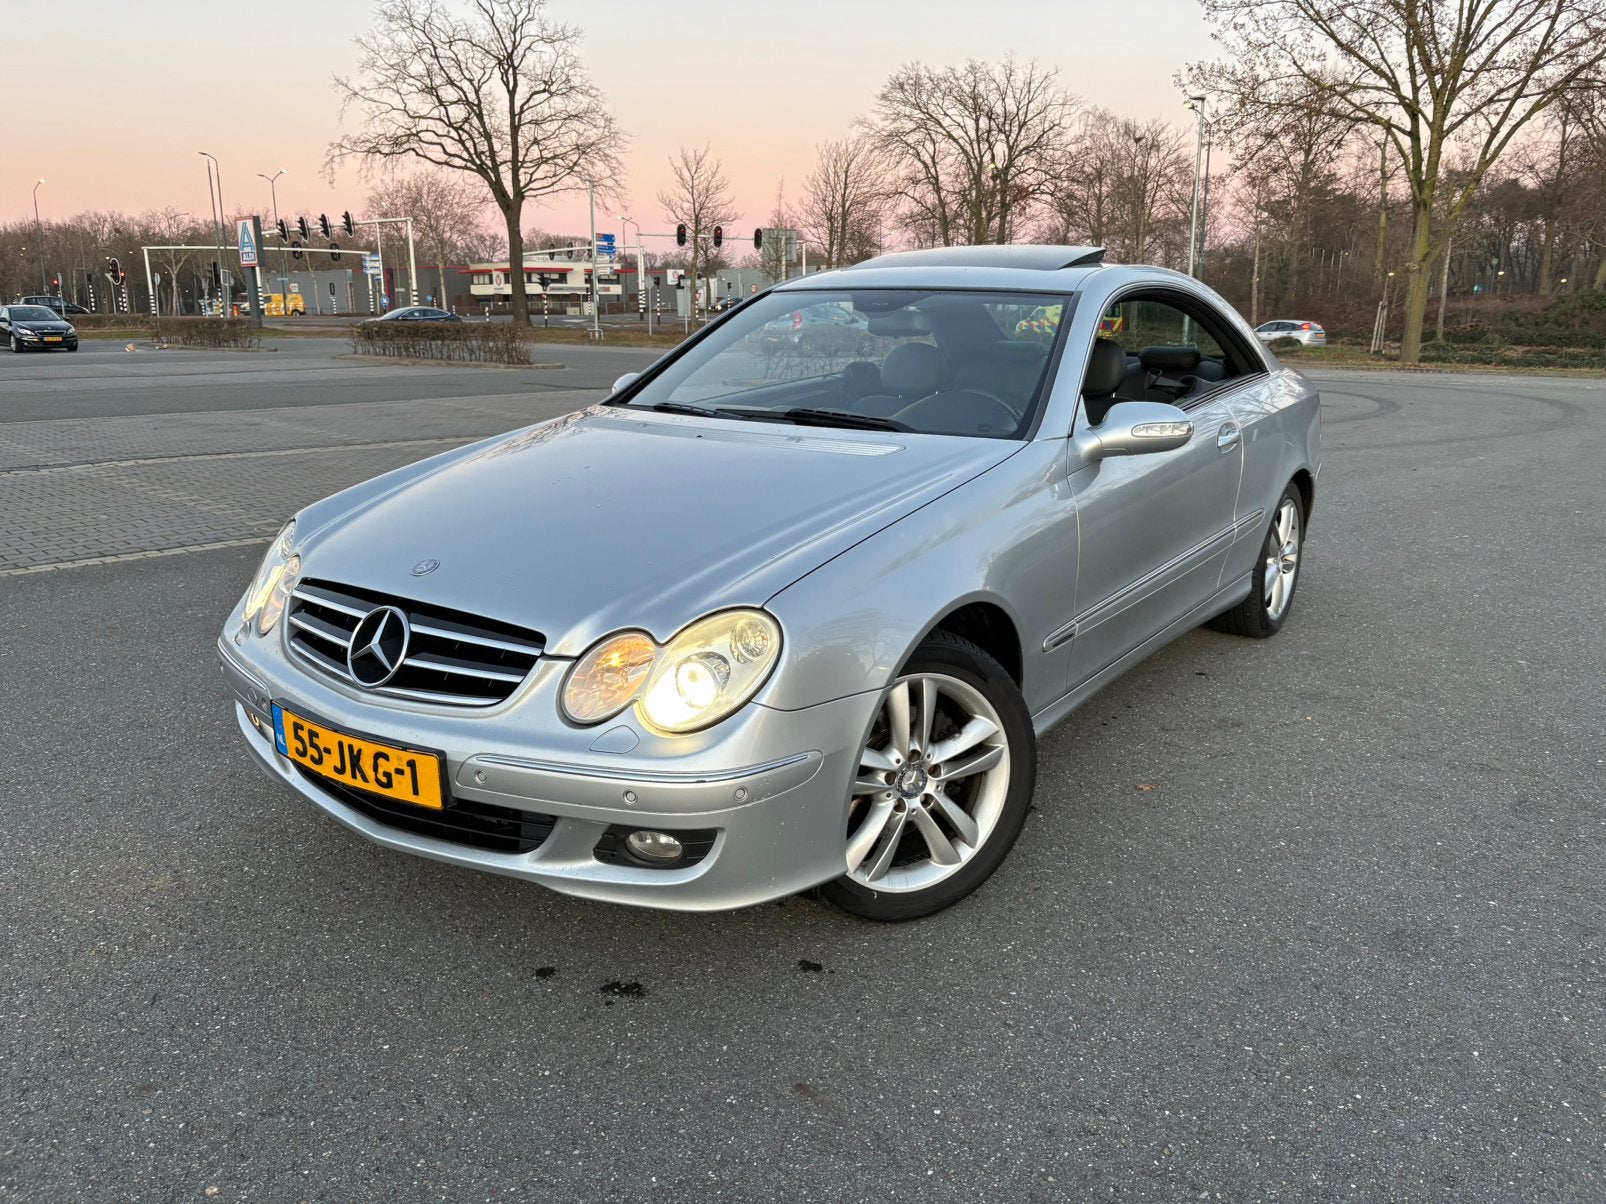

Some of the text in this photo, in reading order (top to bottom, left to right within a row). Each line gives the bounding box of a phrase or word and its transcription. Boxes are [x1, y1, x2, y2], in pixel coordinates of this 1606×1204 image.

[242, 252, 255, 261] ALDI
[276, 732, 286, 746] NL
[292, 721, 420, 796] 55-JKG-1
